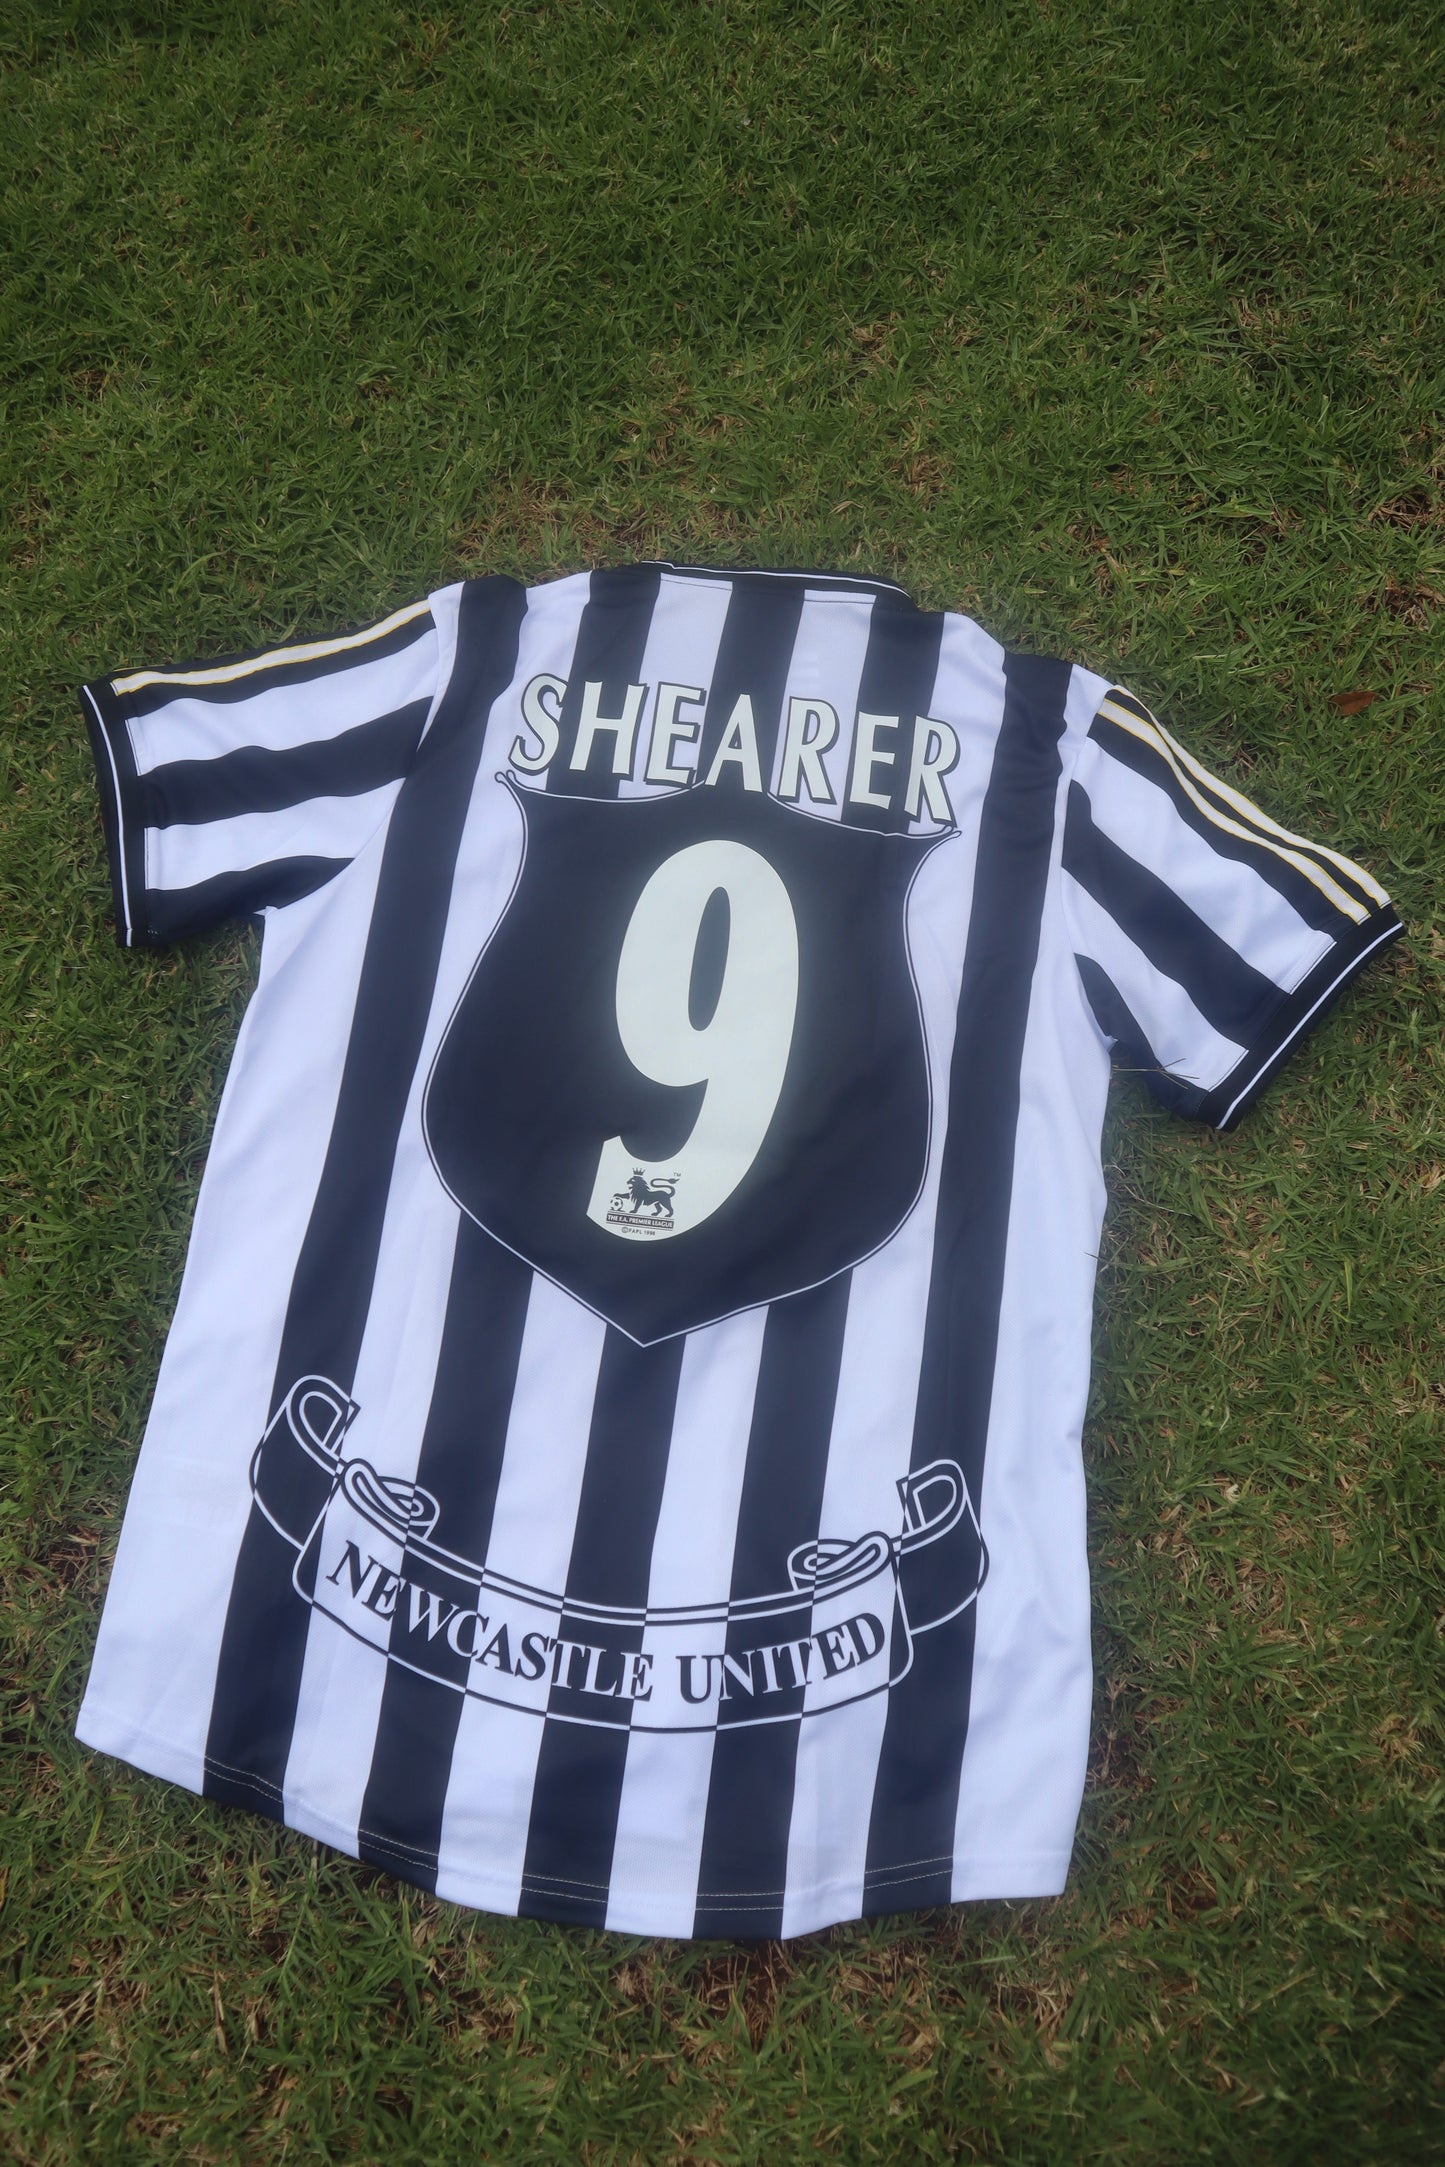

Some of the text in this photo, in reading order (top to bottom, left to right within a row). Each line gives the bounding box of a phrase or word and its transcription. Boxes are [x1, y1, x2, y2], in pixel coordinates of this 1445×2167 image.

[508, 673, 961, 828] SHEARER
[586, 840, 799, 1241] 9
[607, 1214, 619, 1222] THE
[629, 1217, 652, 1226] PREMIER
[652, 1219, 674, 1228] LEAGUE
[326, 1541, 886, 1704] NEWCASTLE UNITED
